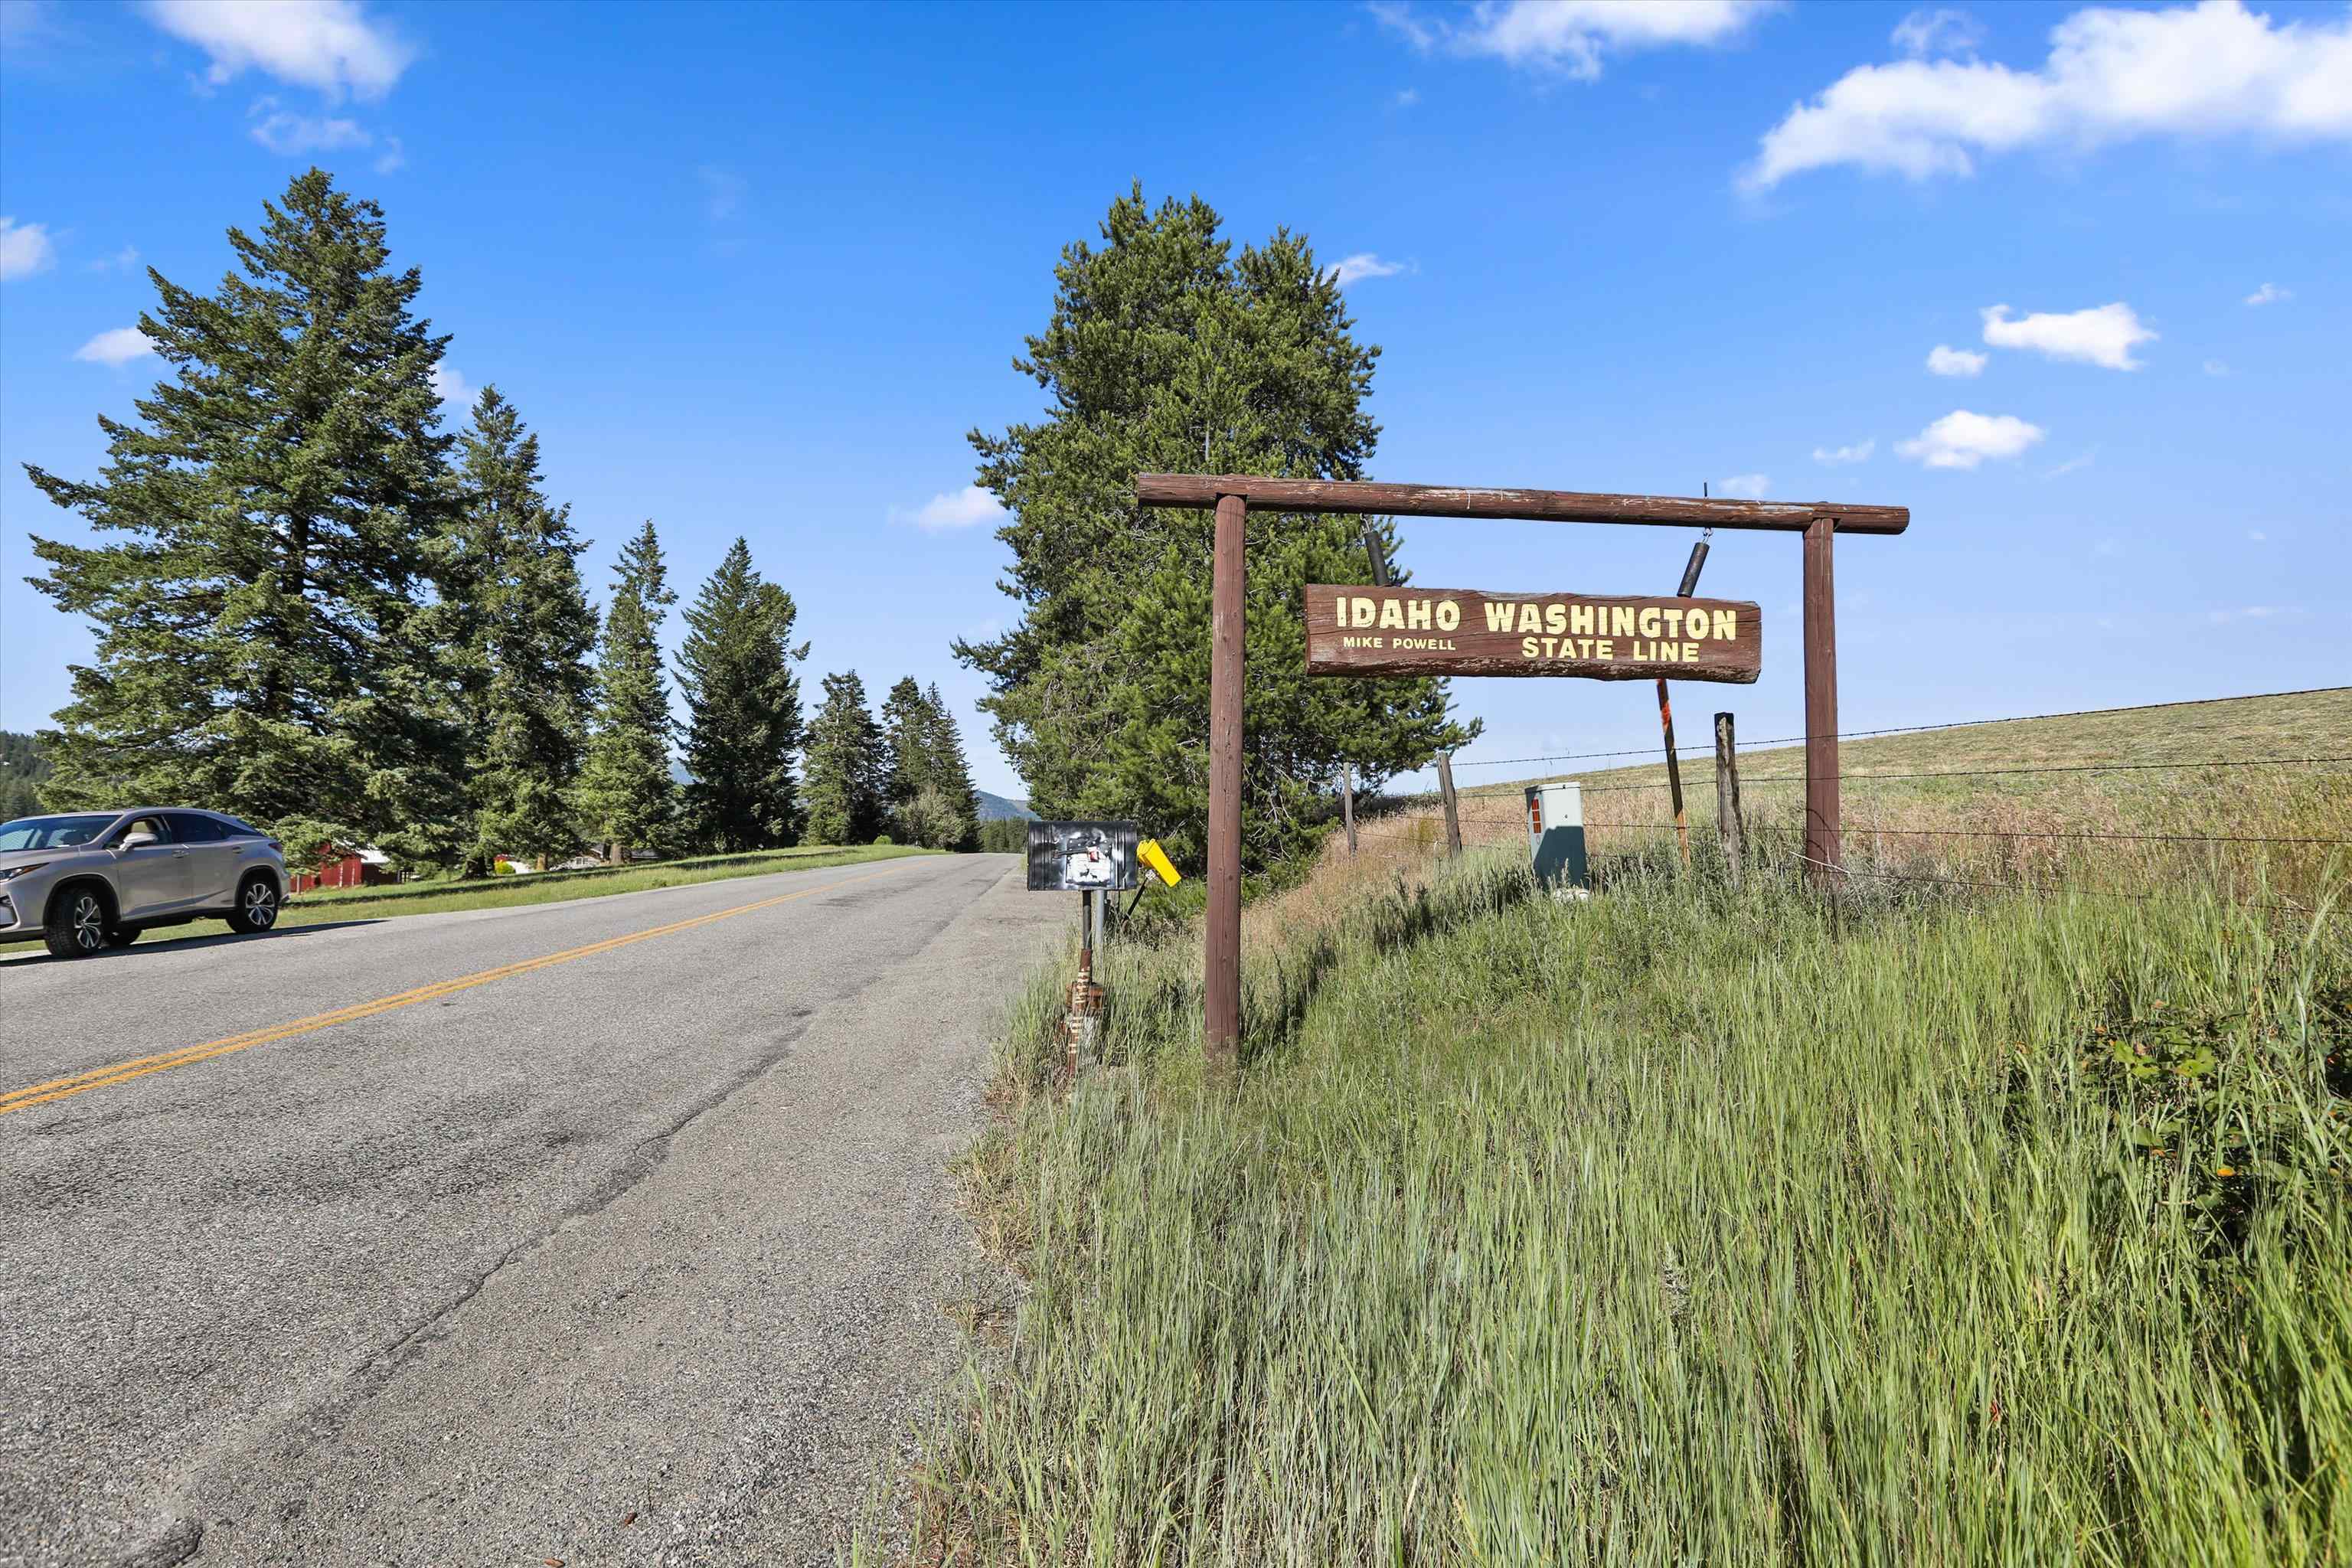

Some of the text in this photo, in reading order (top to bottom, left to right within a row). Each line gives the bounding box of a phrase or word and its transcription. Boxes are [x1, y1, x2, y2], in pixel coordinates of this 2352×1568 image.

[1335, 596, 1737, 641] IDAHO WASHINGTON
[1342, 636, 1457, 651] MIKE POWELL
[1521, 637, 1700, 663] STATE LINE
